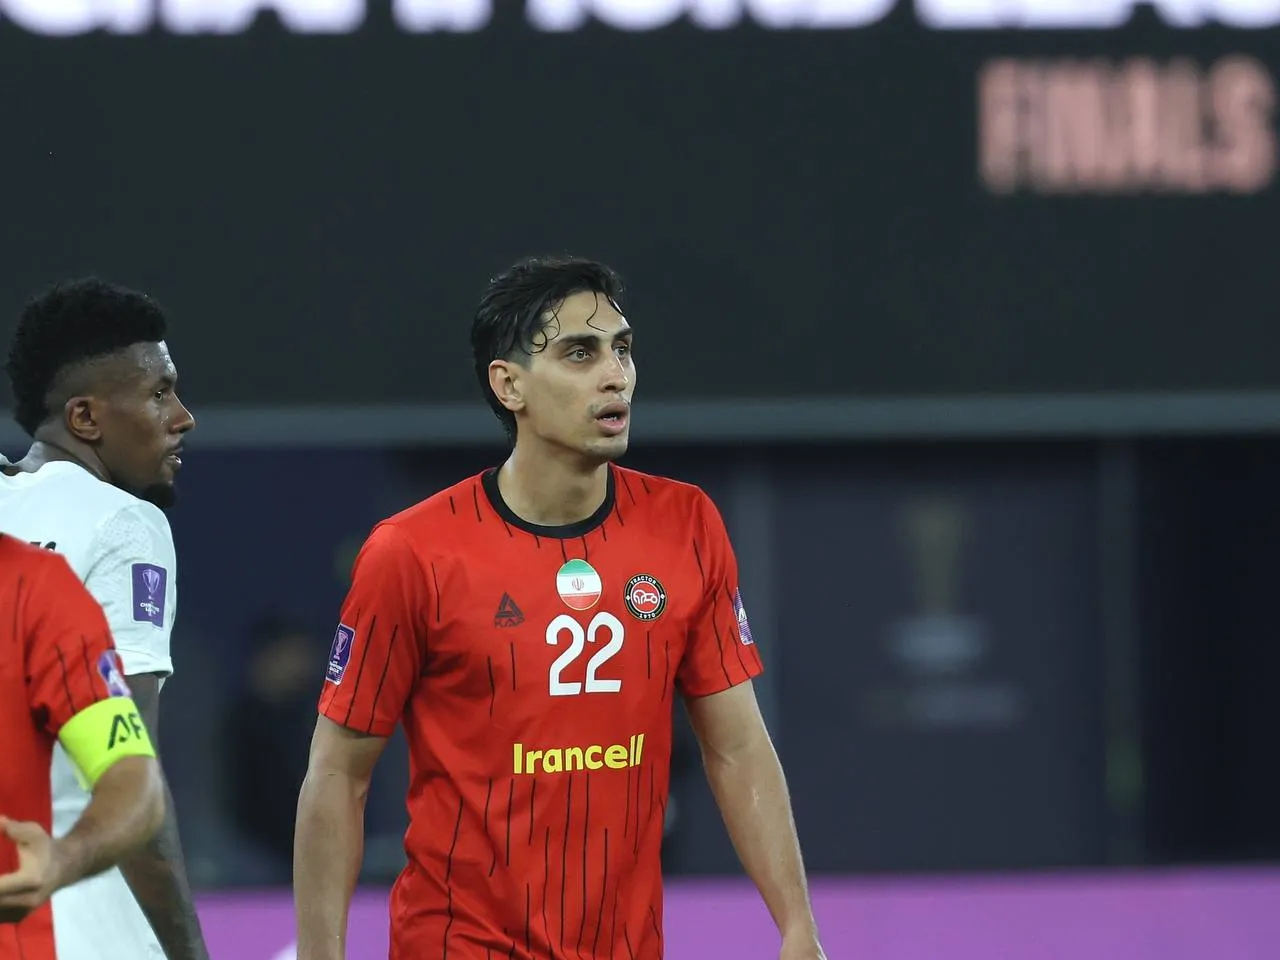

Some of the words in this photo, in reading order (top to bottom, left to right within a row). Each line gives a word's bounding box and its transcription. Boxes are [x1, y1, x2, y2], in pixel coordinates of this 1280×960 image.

[545, 611, 624, 696] 22
[108, 713, 143, 750] AF
[513, 734, 644, 774] Irancell
